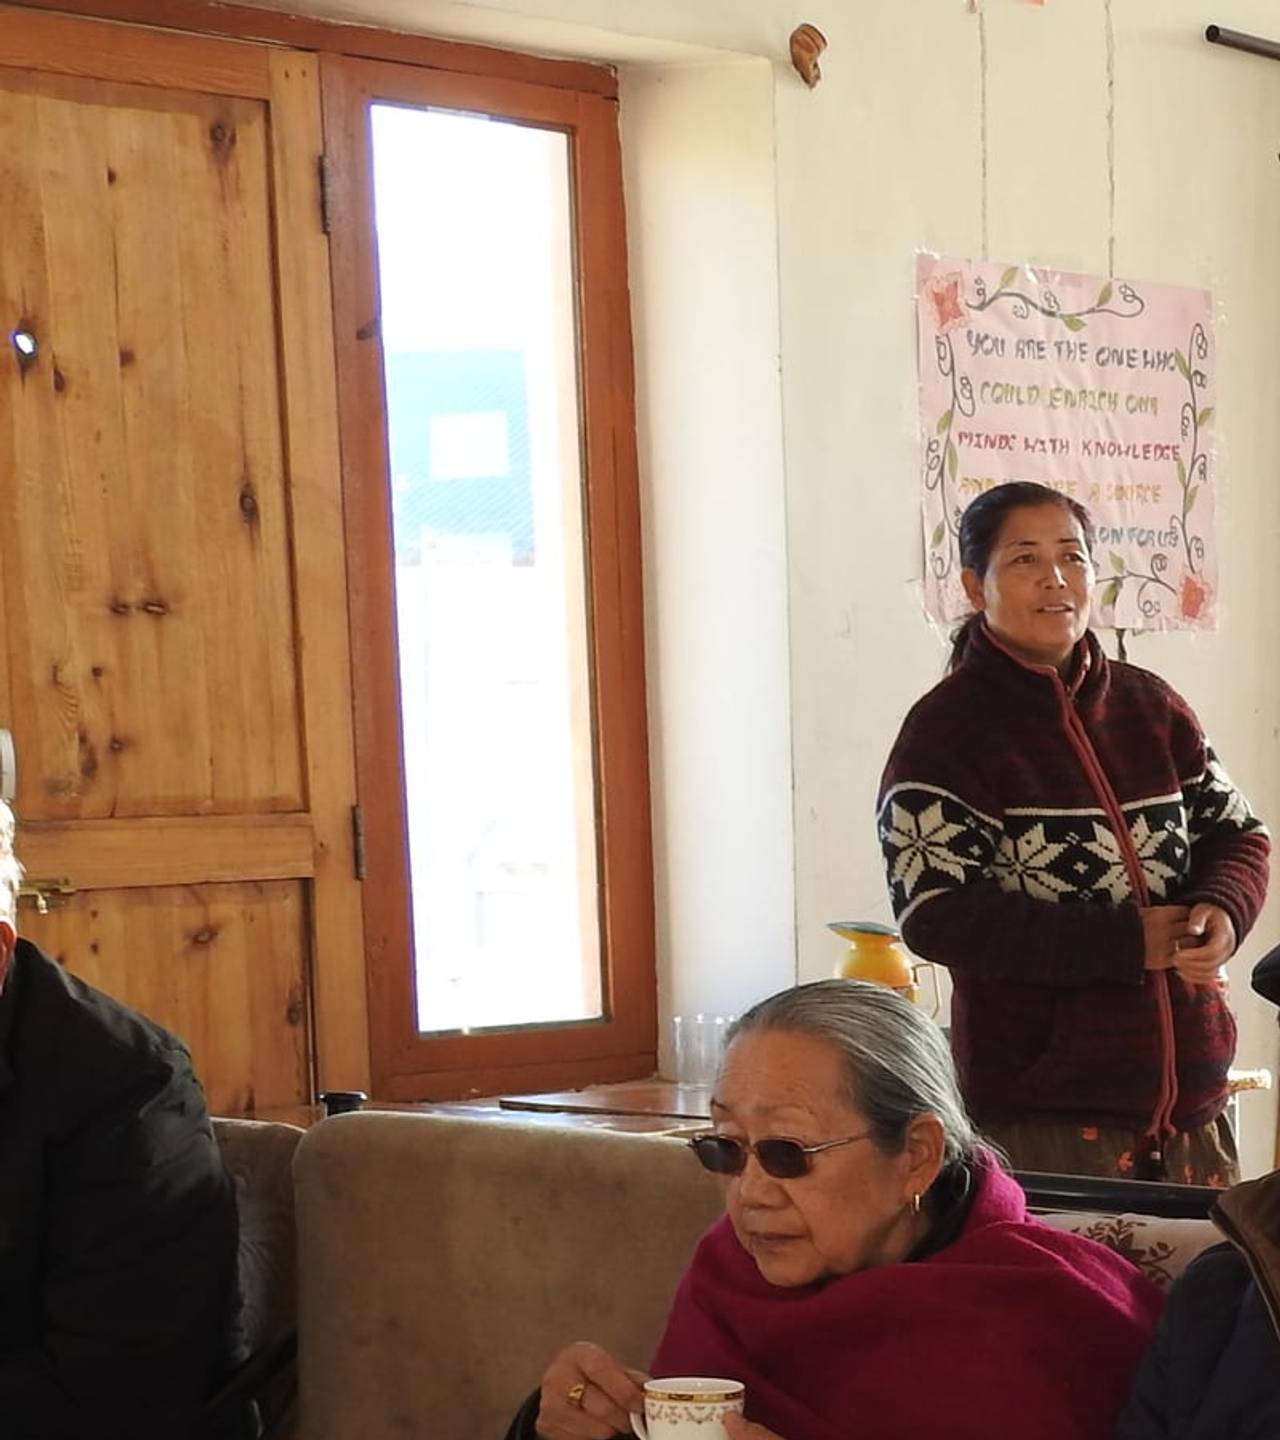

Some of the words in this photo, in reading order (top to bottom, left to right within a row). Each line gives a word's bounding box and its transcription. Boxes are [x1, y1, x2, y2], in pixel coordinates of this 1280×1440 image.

[967, 329, 1005, 357] YOU
[1015, 339, 1046, 360] ARE
[1054, 340, 1088, 362] THE
[1096, 347, 1138, 368] ONE
[980, 381, 1040, 406] COULD
[1049, 387, 1118, 413] ENRICH
[1024, 437, 1070, 454] WITH
[1082, 440, 1180, 462] KNOWLEDGE
